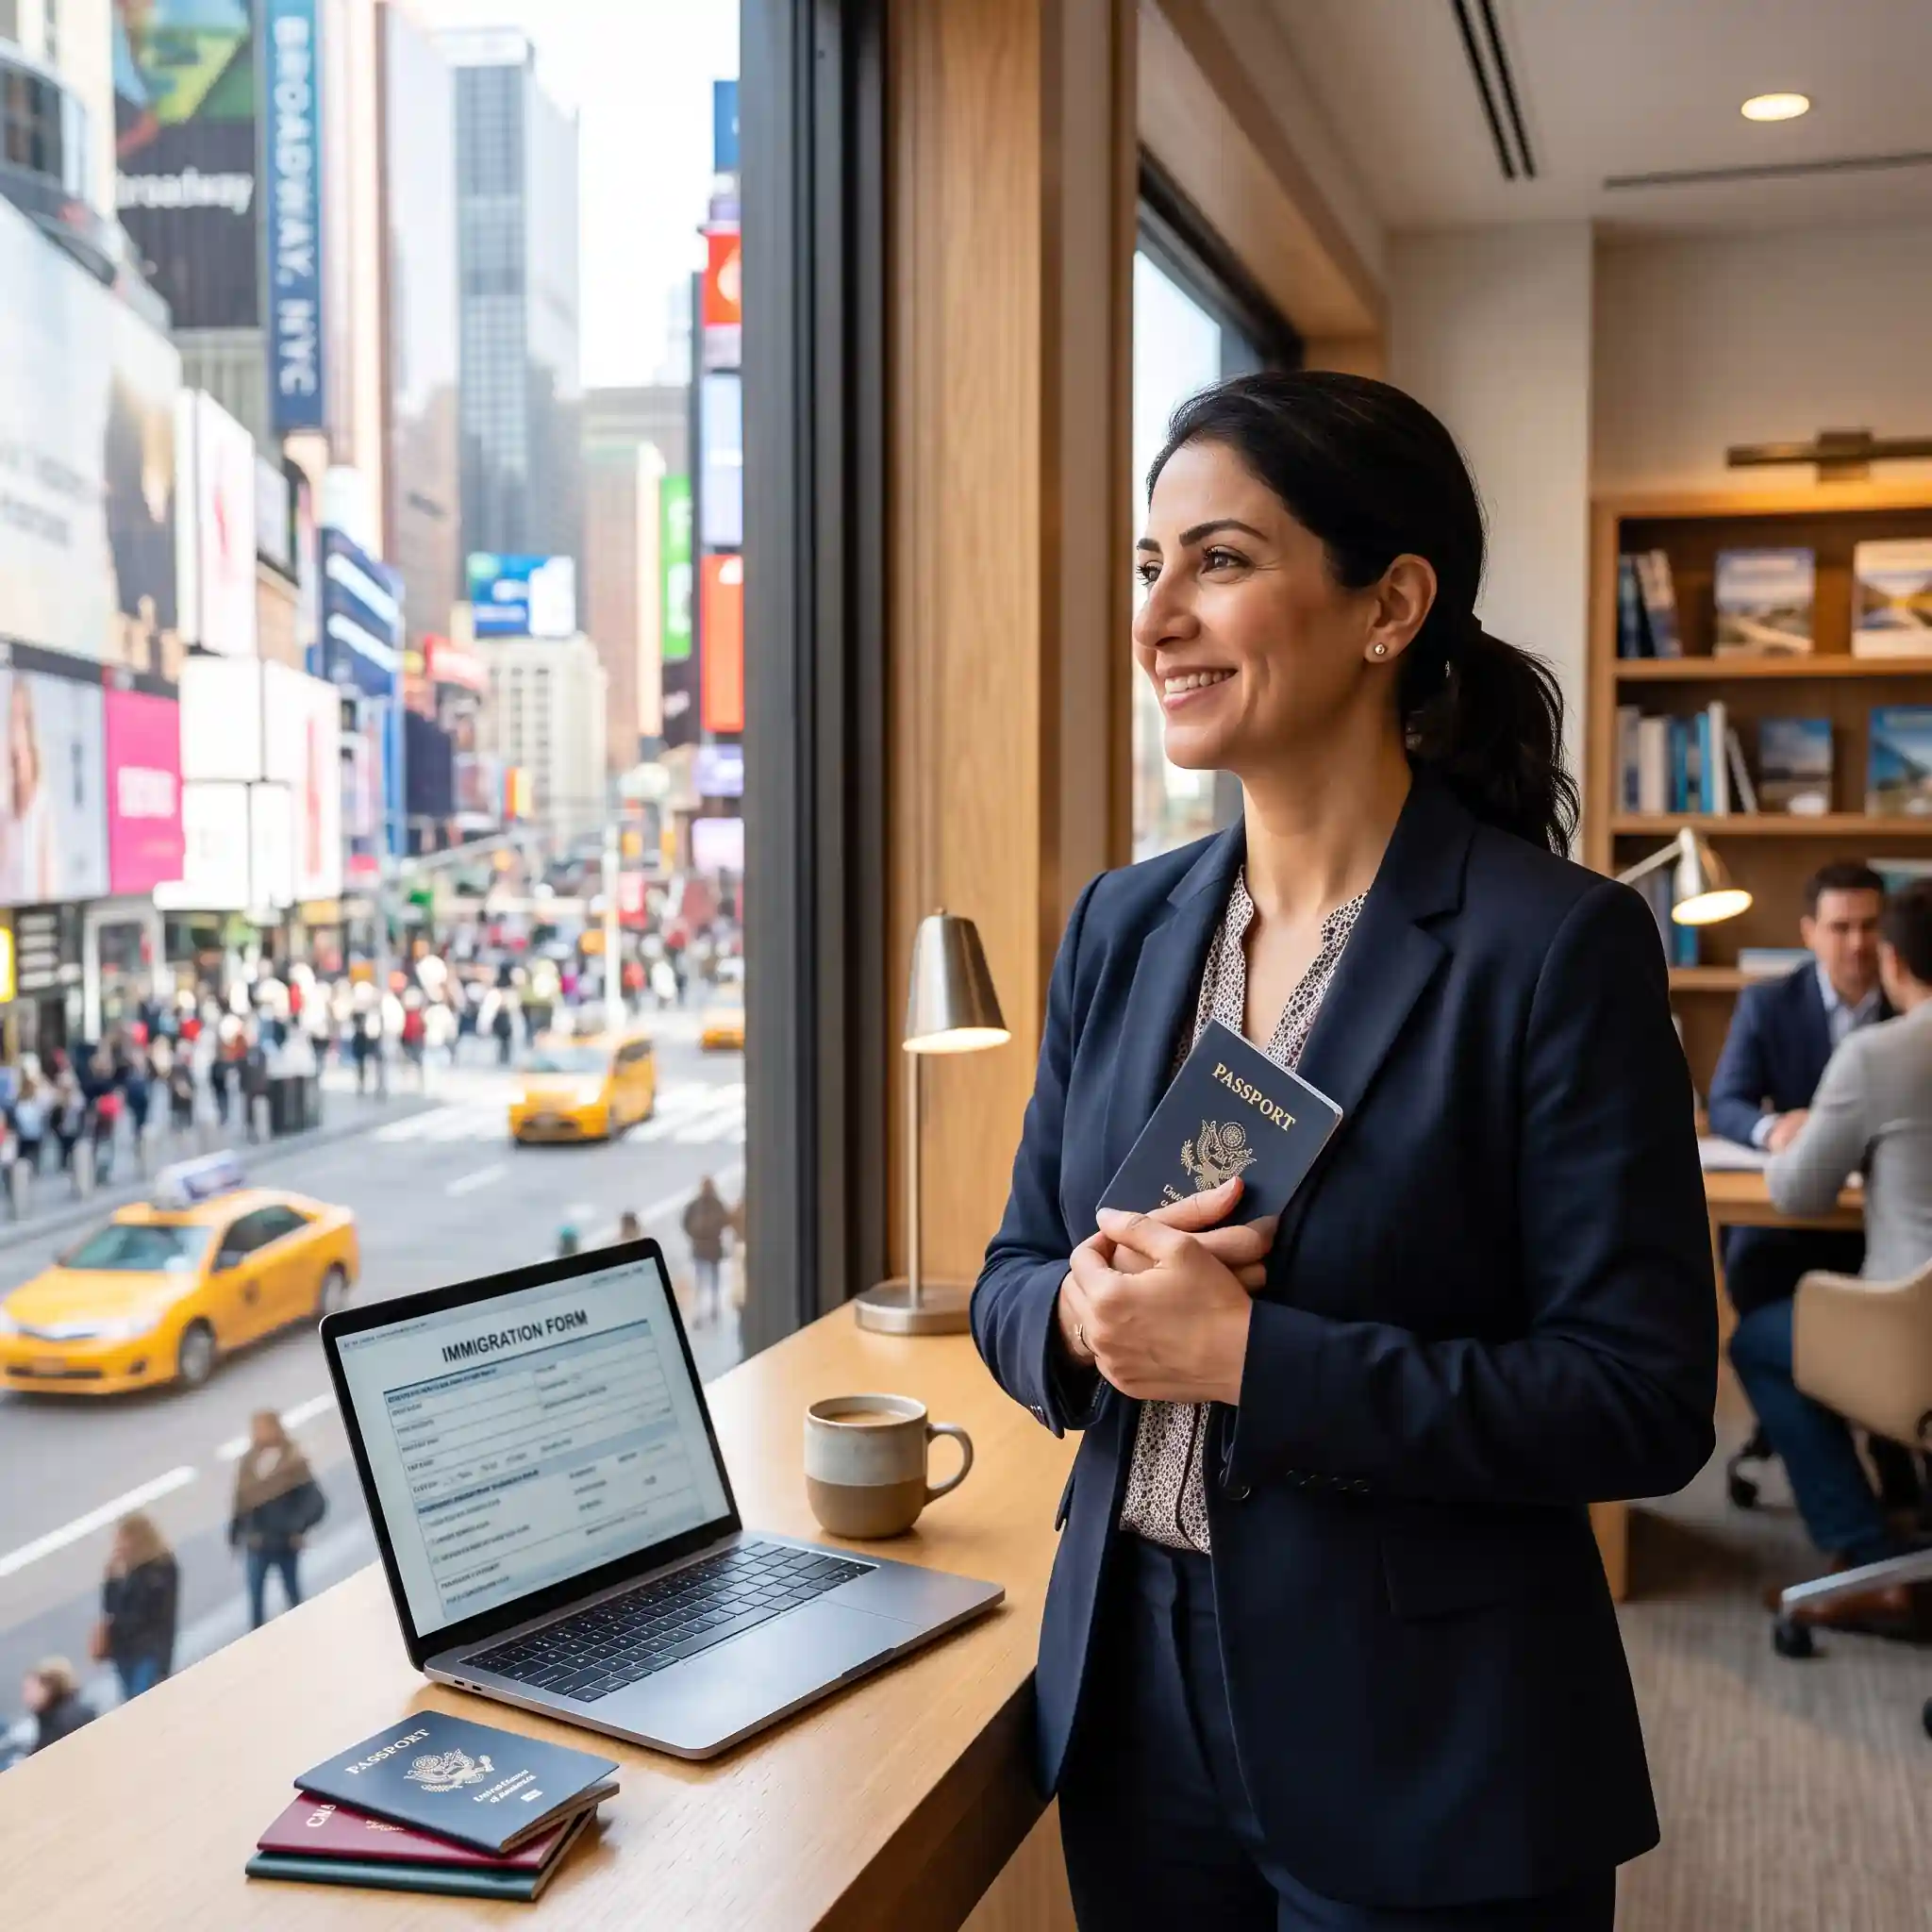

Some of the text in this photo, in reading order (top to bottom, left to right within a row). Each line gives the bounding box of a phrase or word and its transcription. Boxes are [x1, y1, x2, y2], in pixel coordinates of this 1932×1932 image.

[277, 298, 317, 396] NYC
[1211, 1062, 1296, 1131] PASSPORT
[441, 1322, 543, 1362] IMMIGRATION
[545, 1308, 589, 1334] FORM
